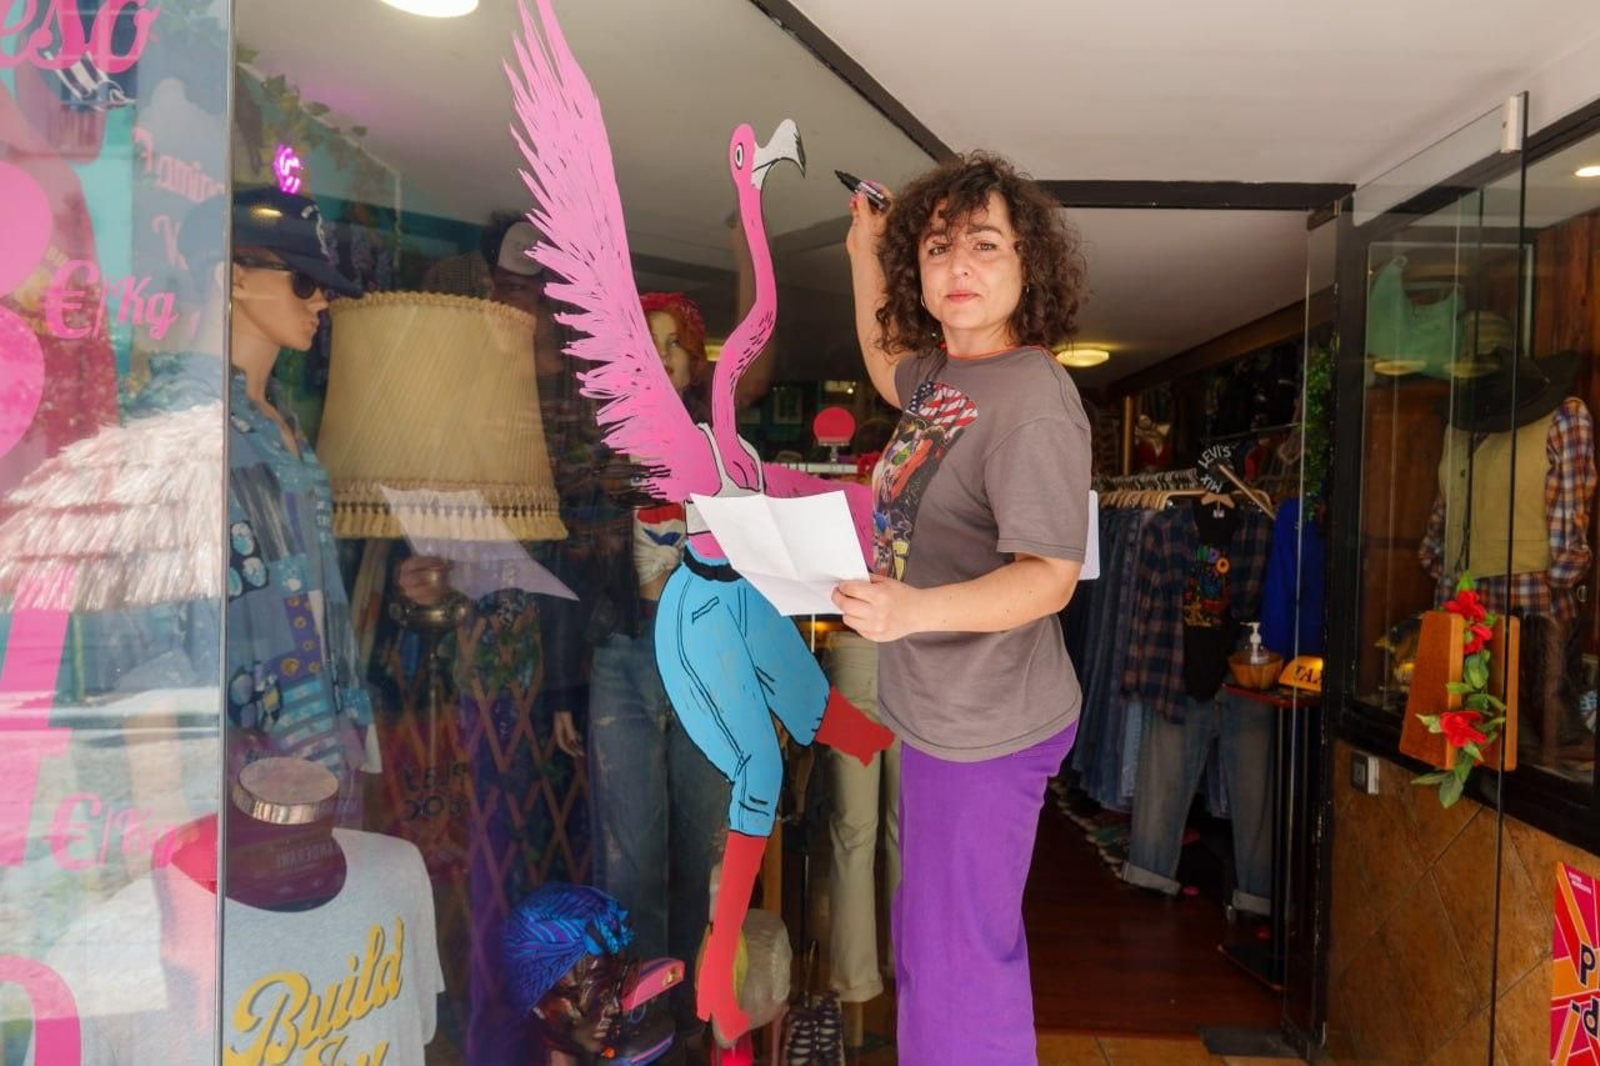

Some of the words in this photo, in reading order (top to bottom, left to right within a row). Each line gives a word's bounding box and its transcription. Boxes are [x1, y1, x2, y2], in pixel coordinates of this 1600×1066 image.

[43, 259, 178, 340] €/Kg
[1197, 444, 1232, 469] LEVI'S
[226, 914, 404, 1066] Build
